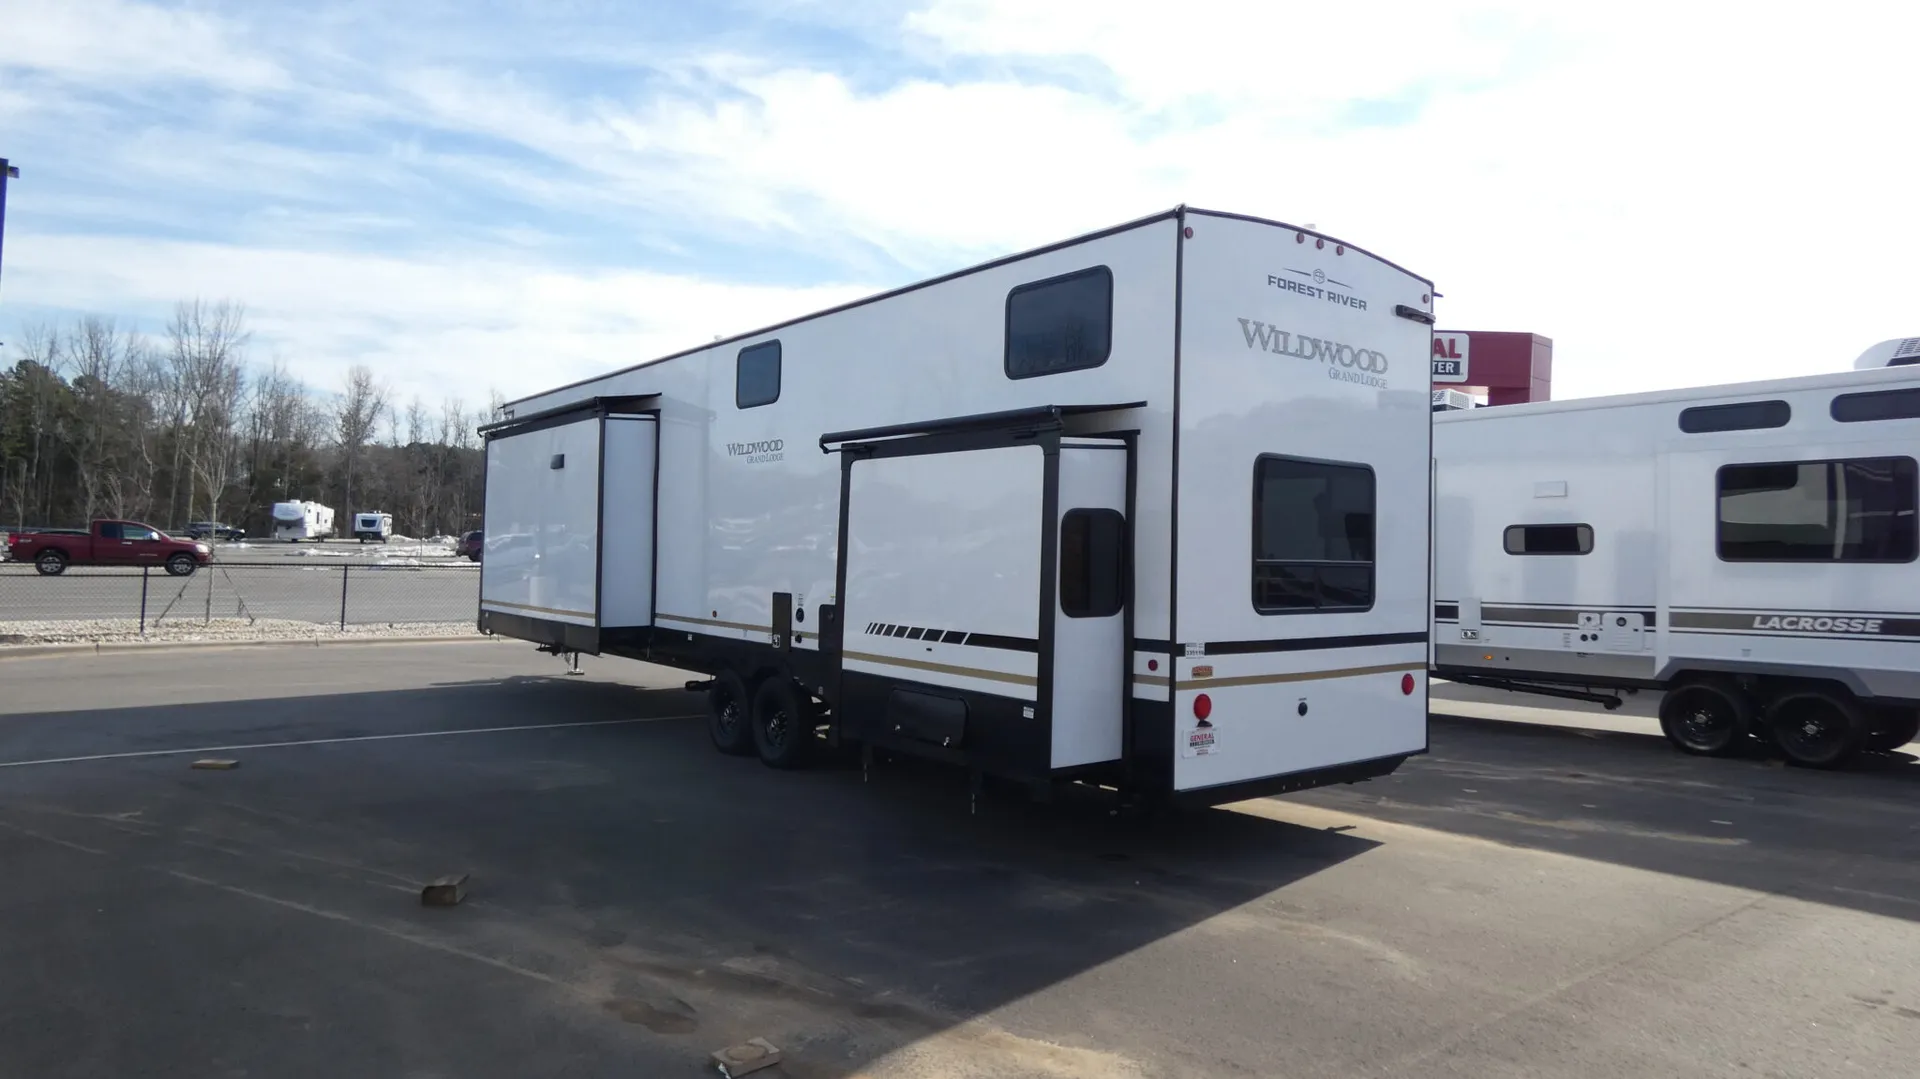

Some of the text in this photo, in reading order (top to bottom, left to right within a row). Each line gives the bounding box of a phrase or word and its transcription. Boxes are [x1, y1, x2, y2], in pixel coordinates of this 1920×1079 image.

[1267, 274, 1367, 311] FOREST RIVER
[1237, 317, 1388, 374] WILDWOOD
[726, 439, 784, 456] WILDWOOD
[1752, 615, 1884, 633] LACROSSE
